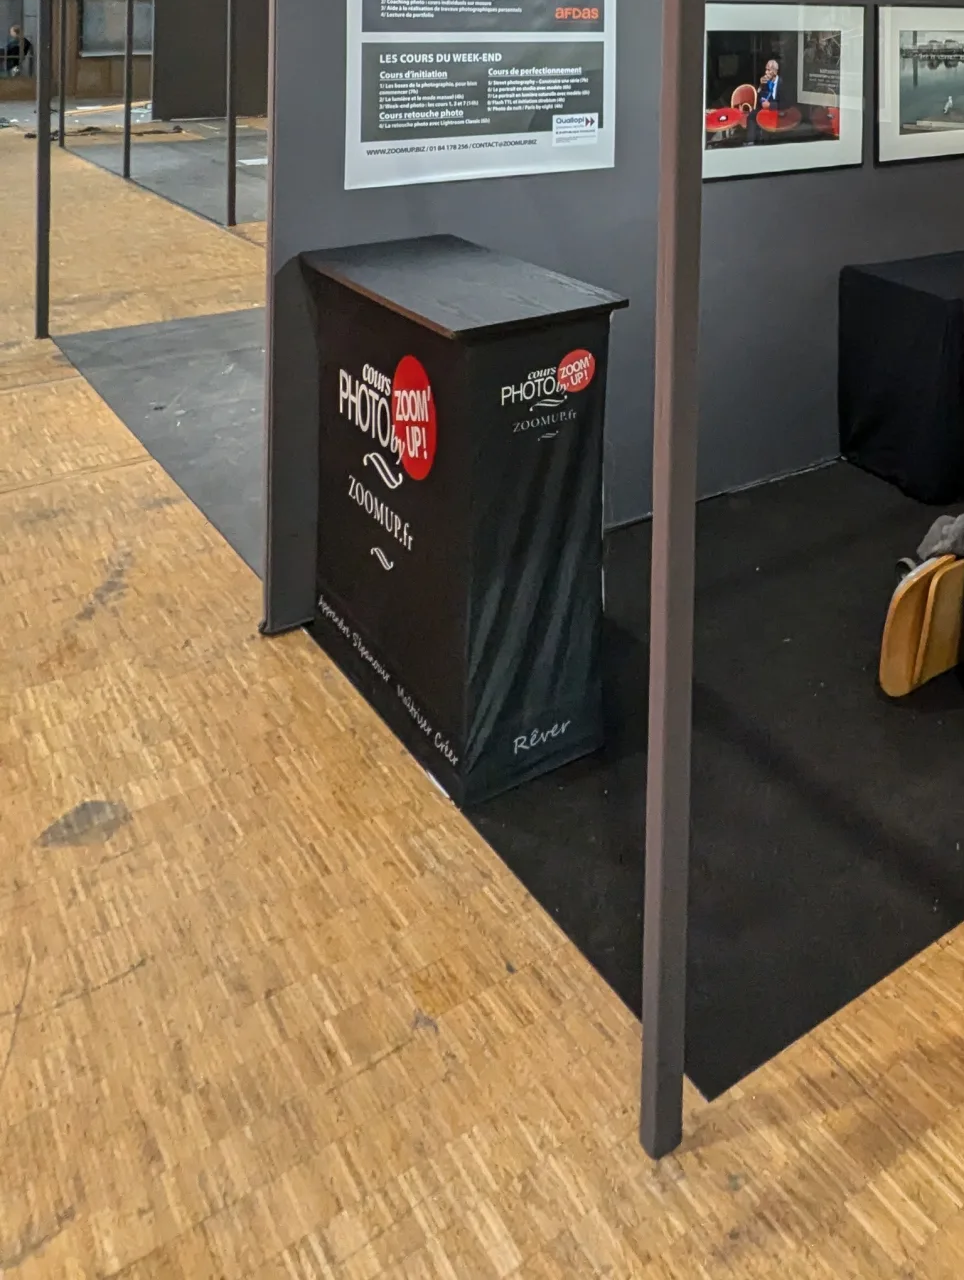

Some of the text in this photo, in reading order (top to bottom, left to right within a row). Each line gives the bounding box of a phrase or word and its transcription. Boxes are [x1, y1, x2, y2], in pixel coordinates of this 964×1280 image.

[379, 52, 502, 64] LES COURS DU WEEK-END
[488, 66, 582, 77] Cours de perfectionnement
[379, 70, 448, 79] Cours d'initiation
[379, 109, 464, 120] Cours retouche photo
[362, 363, 392, 394] cours
[528, 366, 557, 381] cours
[559, 353, 593, 380] ZOOM'
[571, 370, 589, 387] UP!
[394, 385, 432, 423] ZOOM'
[500, 375, 569, 406] PHOTO by
[339, 368, 406, 466] PHOTO by
[513, 409, 578, 434] ZOOMUP.fr
[405, 425, 428, 460] UP!
[348, 474, 413, 551] ZOOMUP.fr
[513, 720, 571, 755] Rêver
